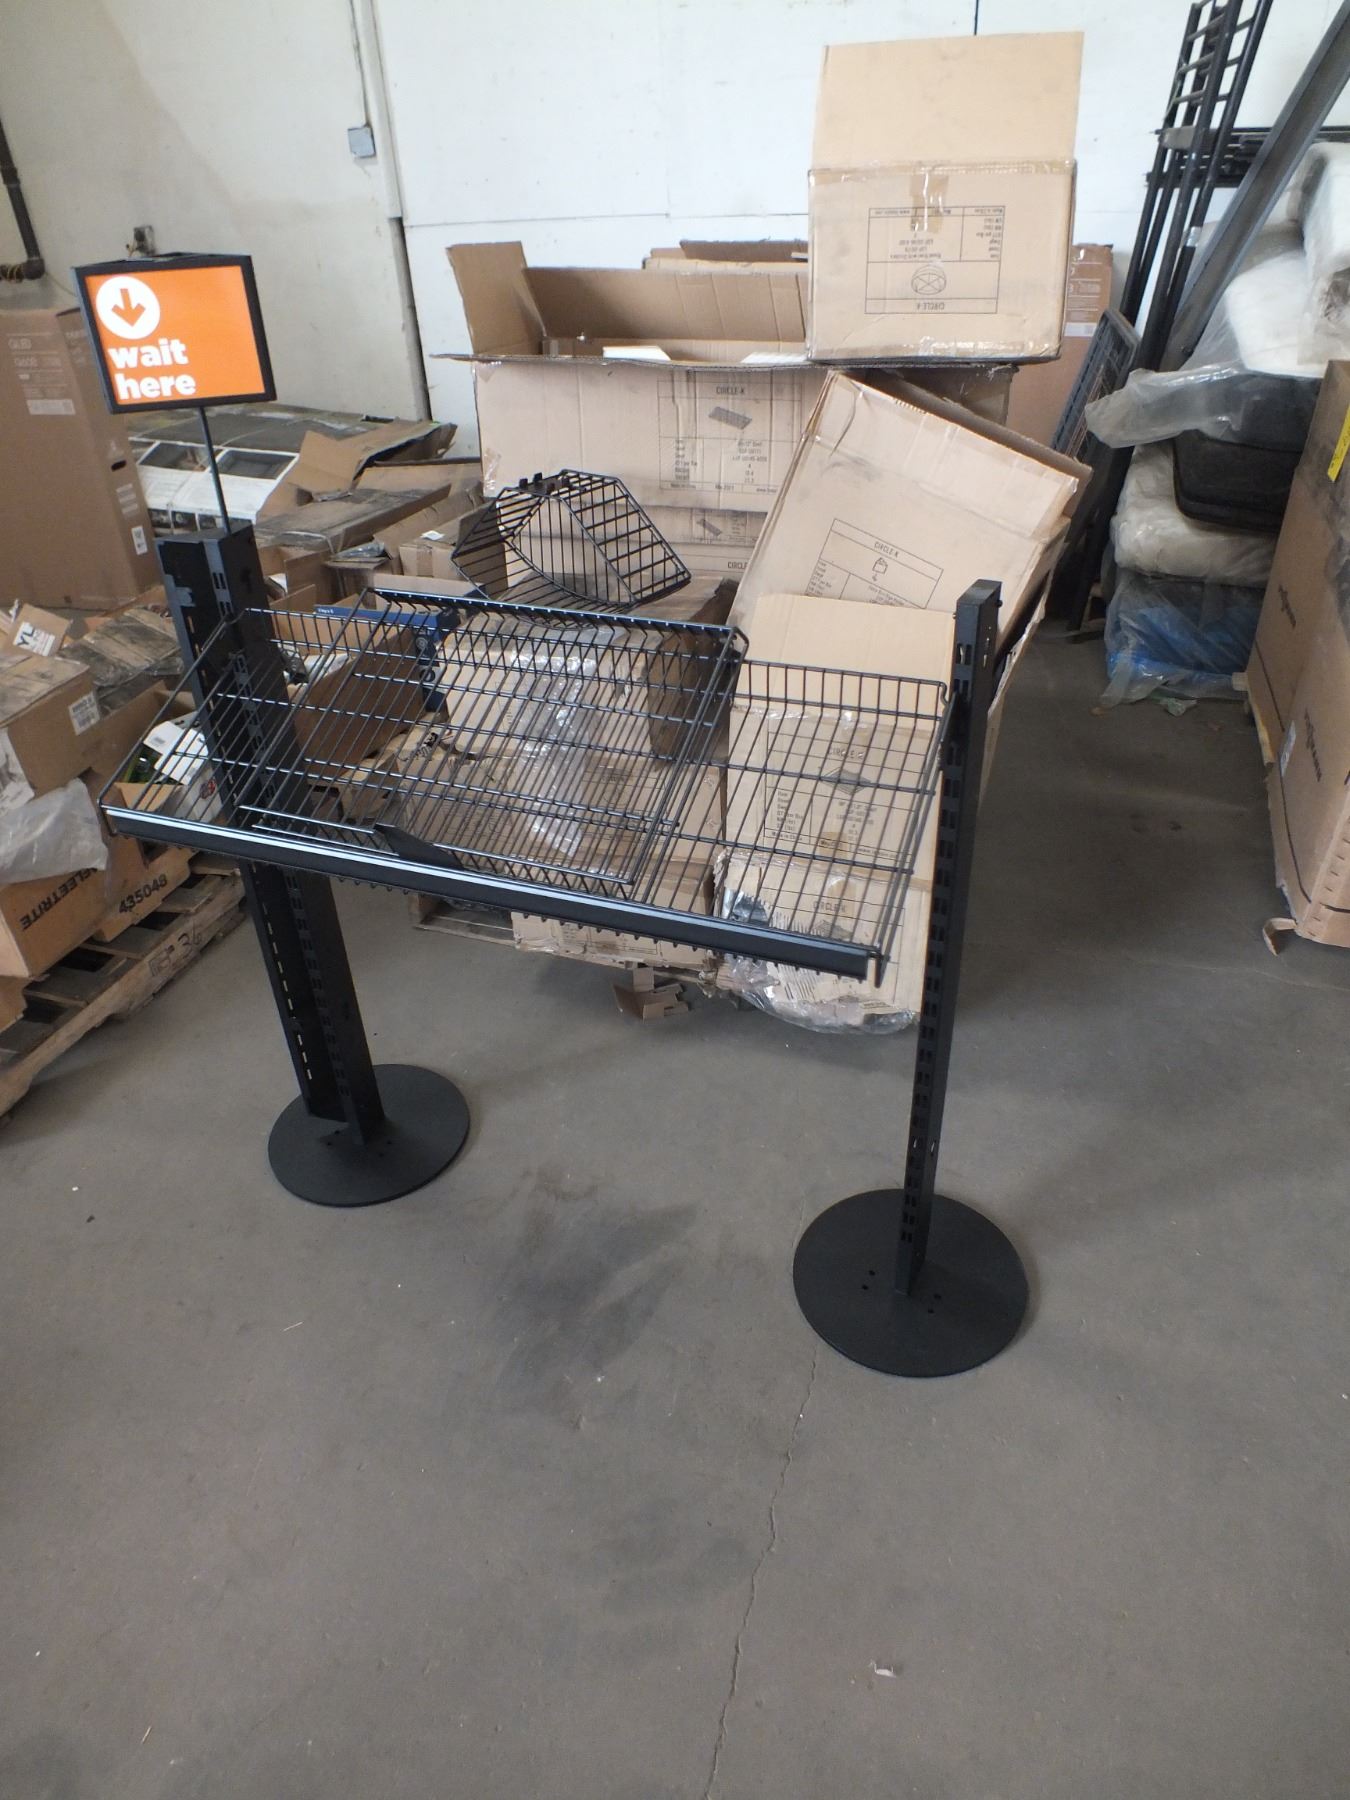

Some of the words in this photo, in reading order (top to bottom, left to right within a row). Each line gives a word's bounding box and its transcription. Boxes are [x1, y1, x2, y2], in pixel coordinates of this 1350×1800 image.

[108, 338, 189, 368] wait
[115, 373, 196, 400] here
[119, 874, 168, 914] 435048
